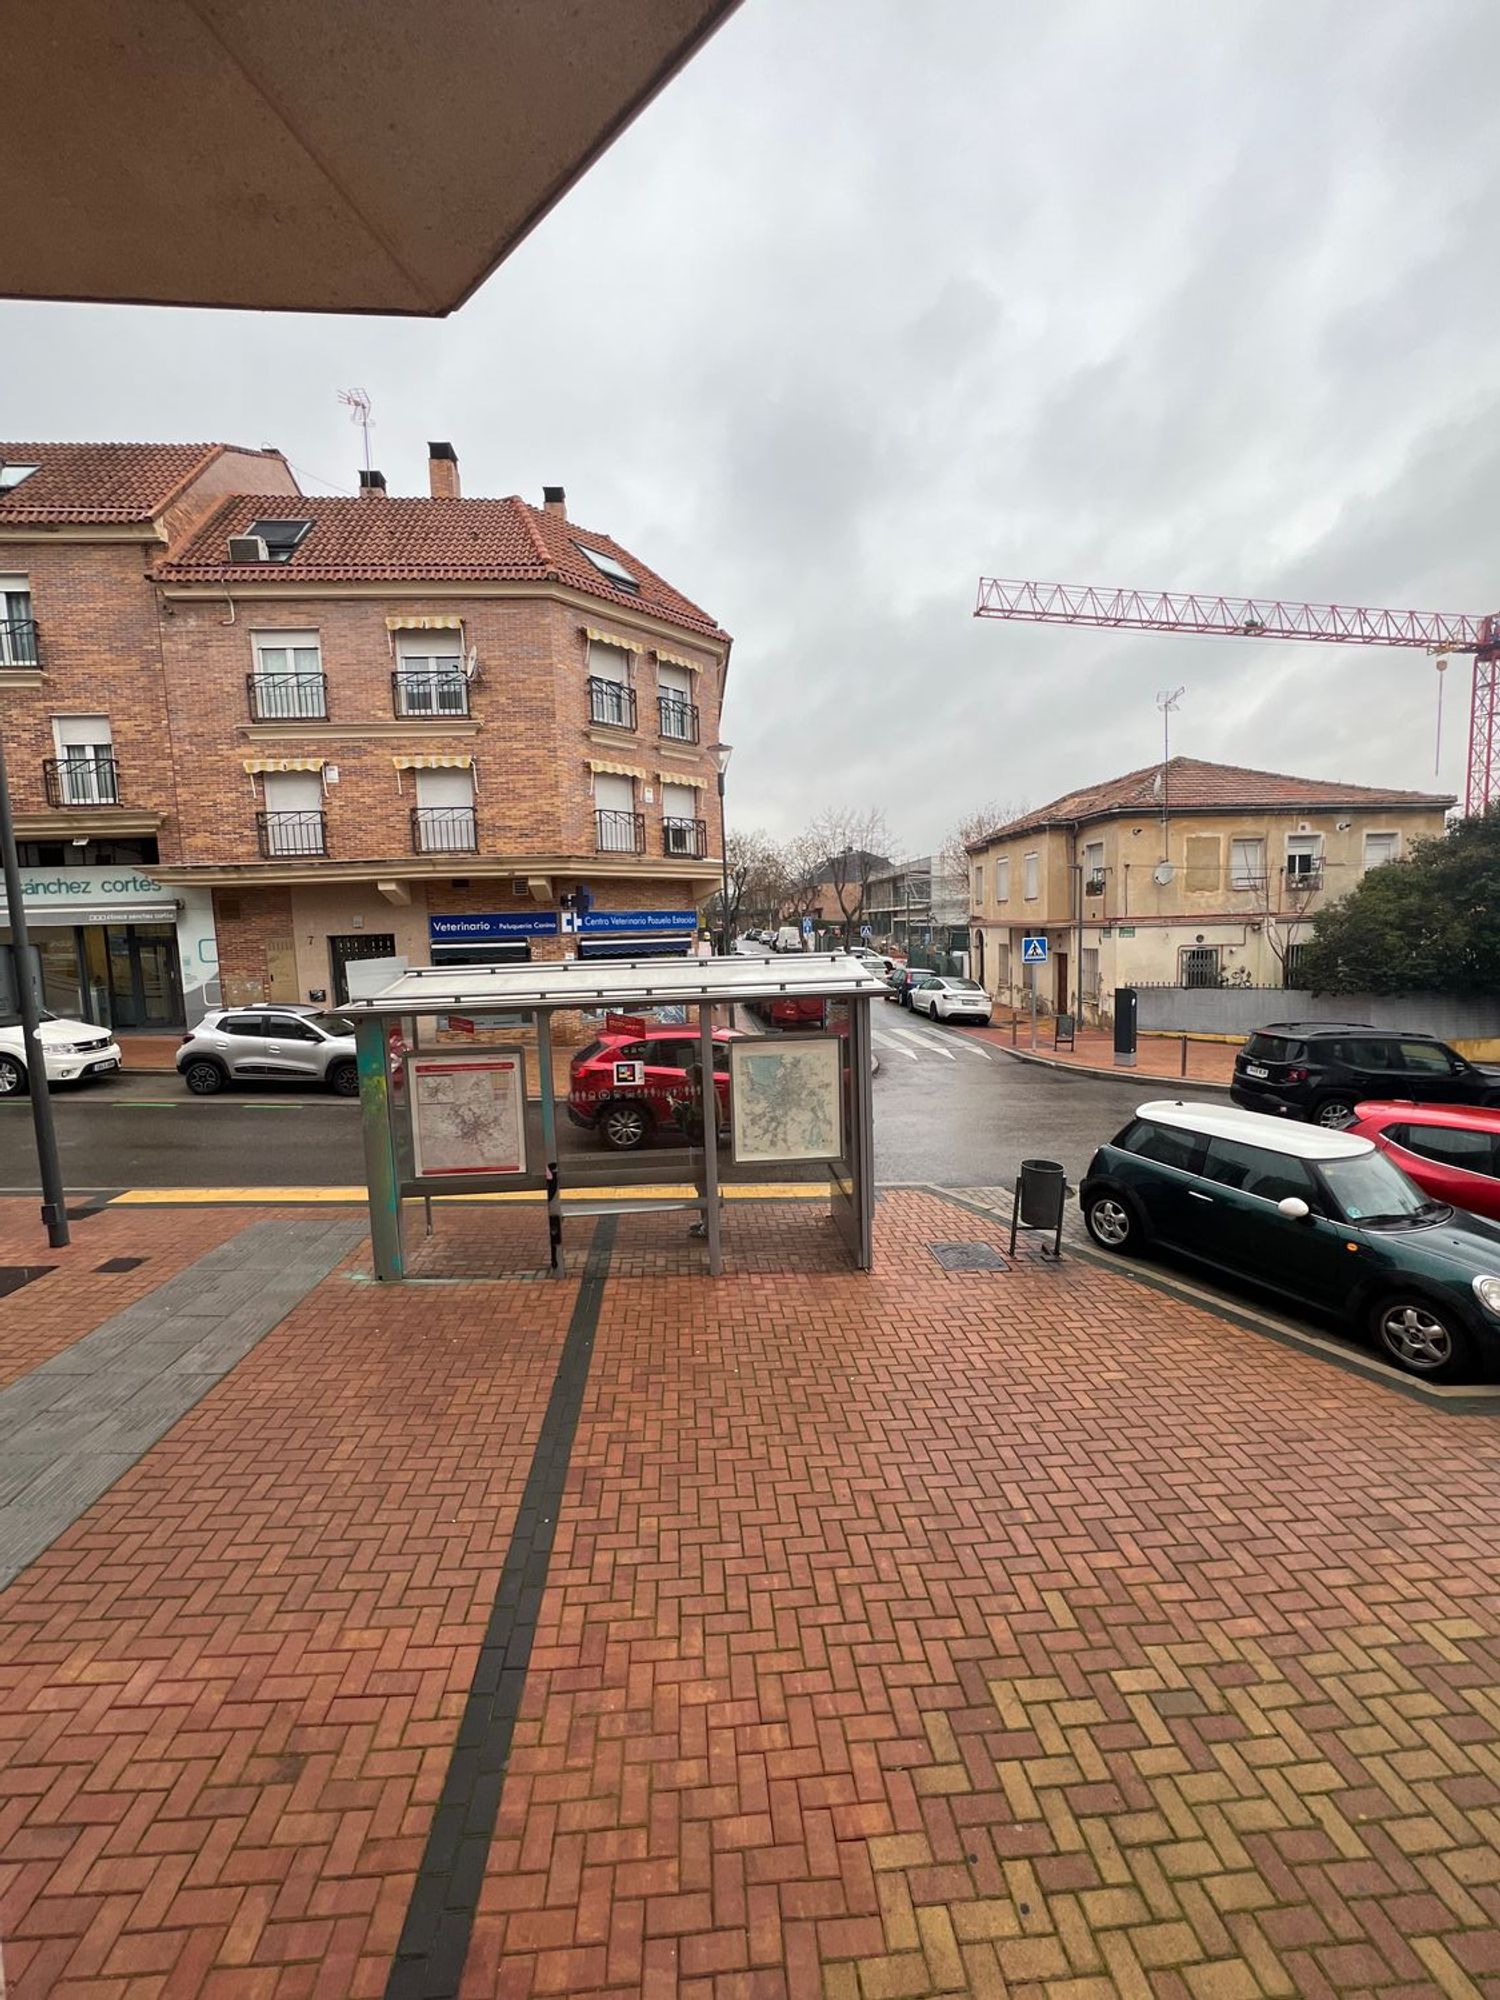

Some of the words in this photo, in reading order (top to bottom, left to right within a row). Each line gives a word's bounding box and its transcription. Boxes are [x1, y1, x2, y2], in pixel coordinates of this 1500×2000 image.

[101, 875, 162, 893] cortés
[585, 916, 609, 926] Centro
[610, 916, 646, 925] Veterinario
[647, 915, 671, 925] Pozuelo
[433, 921, 491, 932] Veterinario
[533, 921, 556, 929] Canina
